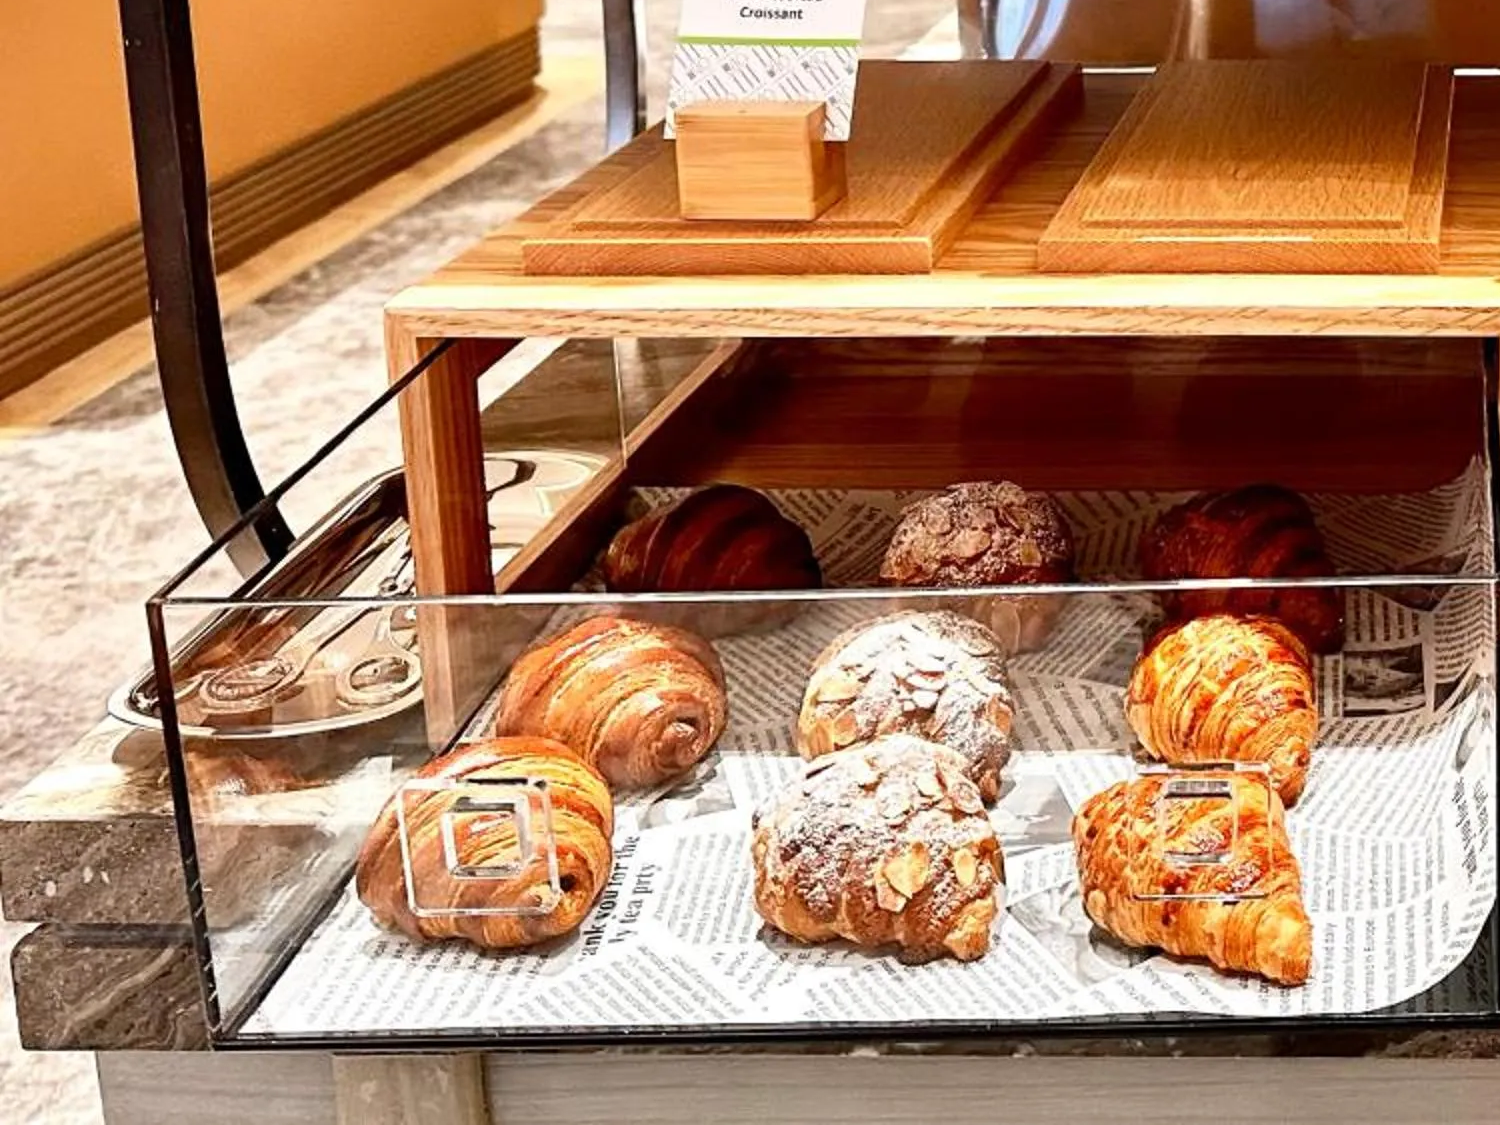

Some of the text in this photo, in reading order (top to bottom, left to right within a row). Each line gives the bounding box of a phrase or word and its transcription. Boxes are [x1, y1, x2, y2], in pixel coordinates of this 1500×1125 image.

[739, 5, 804, 20] Croissant
[594, 889, 619, 920] you
[613, 836, 641, 860] the
[618, 899, 644, 924] tea
